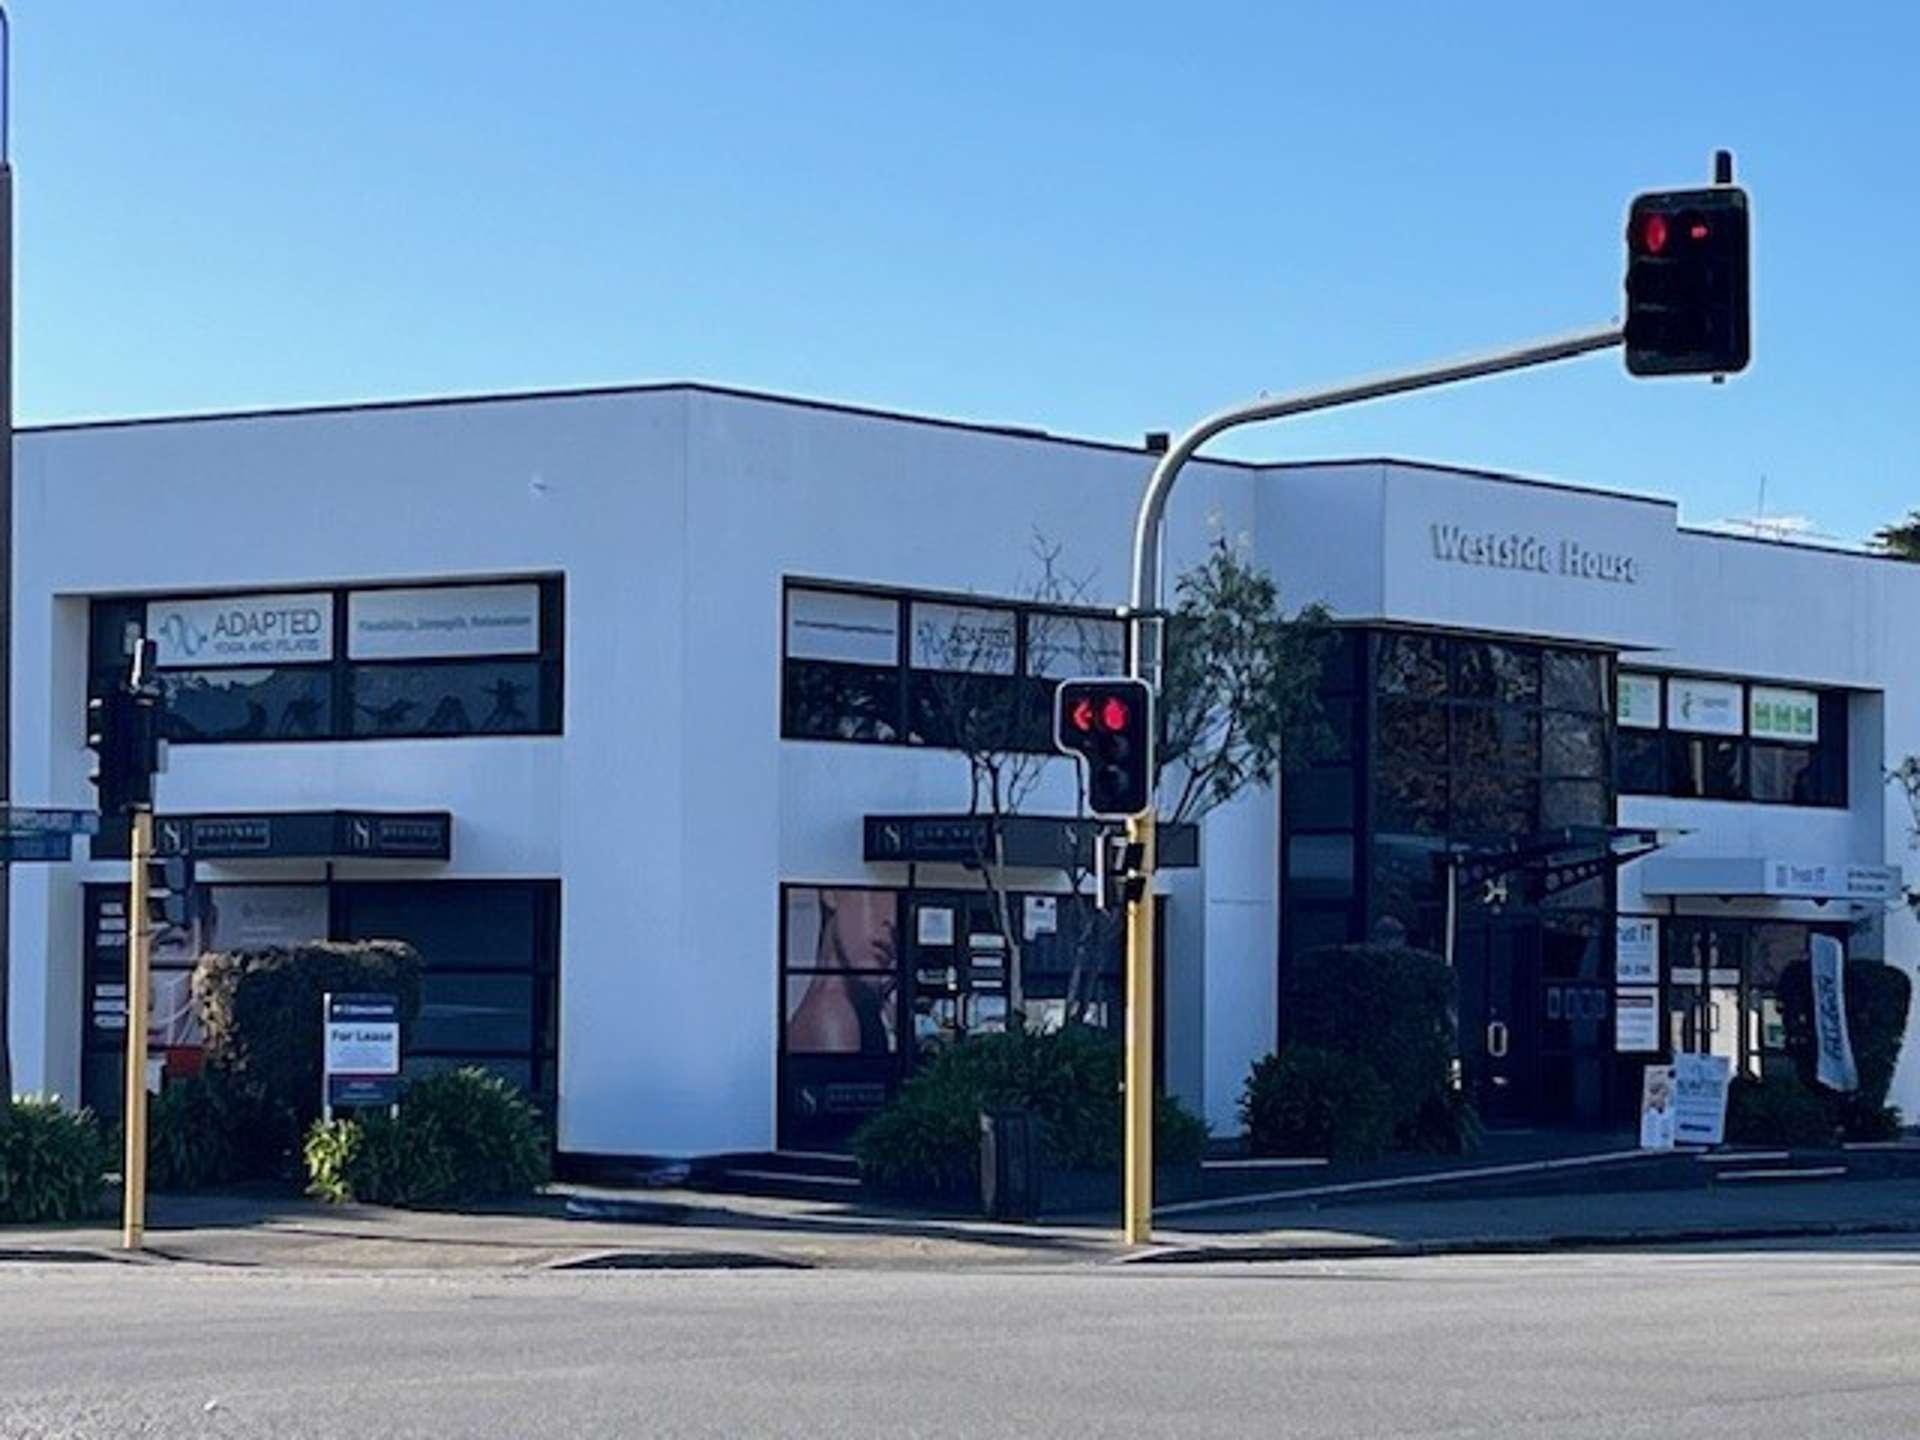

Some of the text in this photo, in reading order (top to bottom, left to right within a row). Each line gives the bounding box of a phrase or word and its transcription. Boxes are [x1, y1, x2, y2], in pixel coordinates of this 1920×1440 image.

[1428, 523, 1640, 584] Westside House
[213, 608, 322, 638] ADAPTED
[331, 1028, 394, 1042] For Lease
